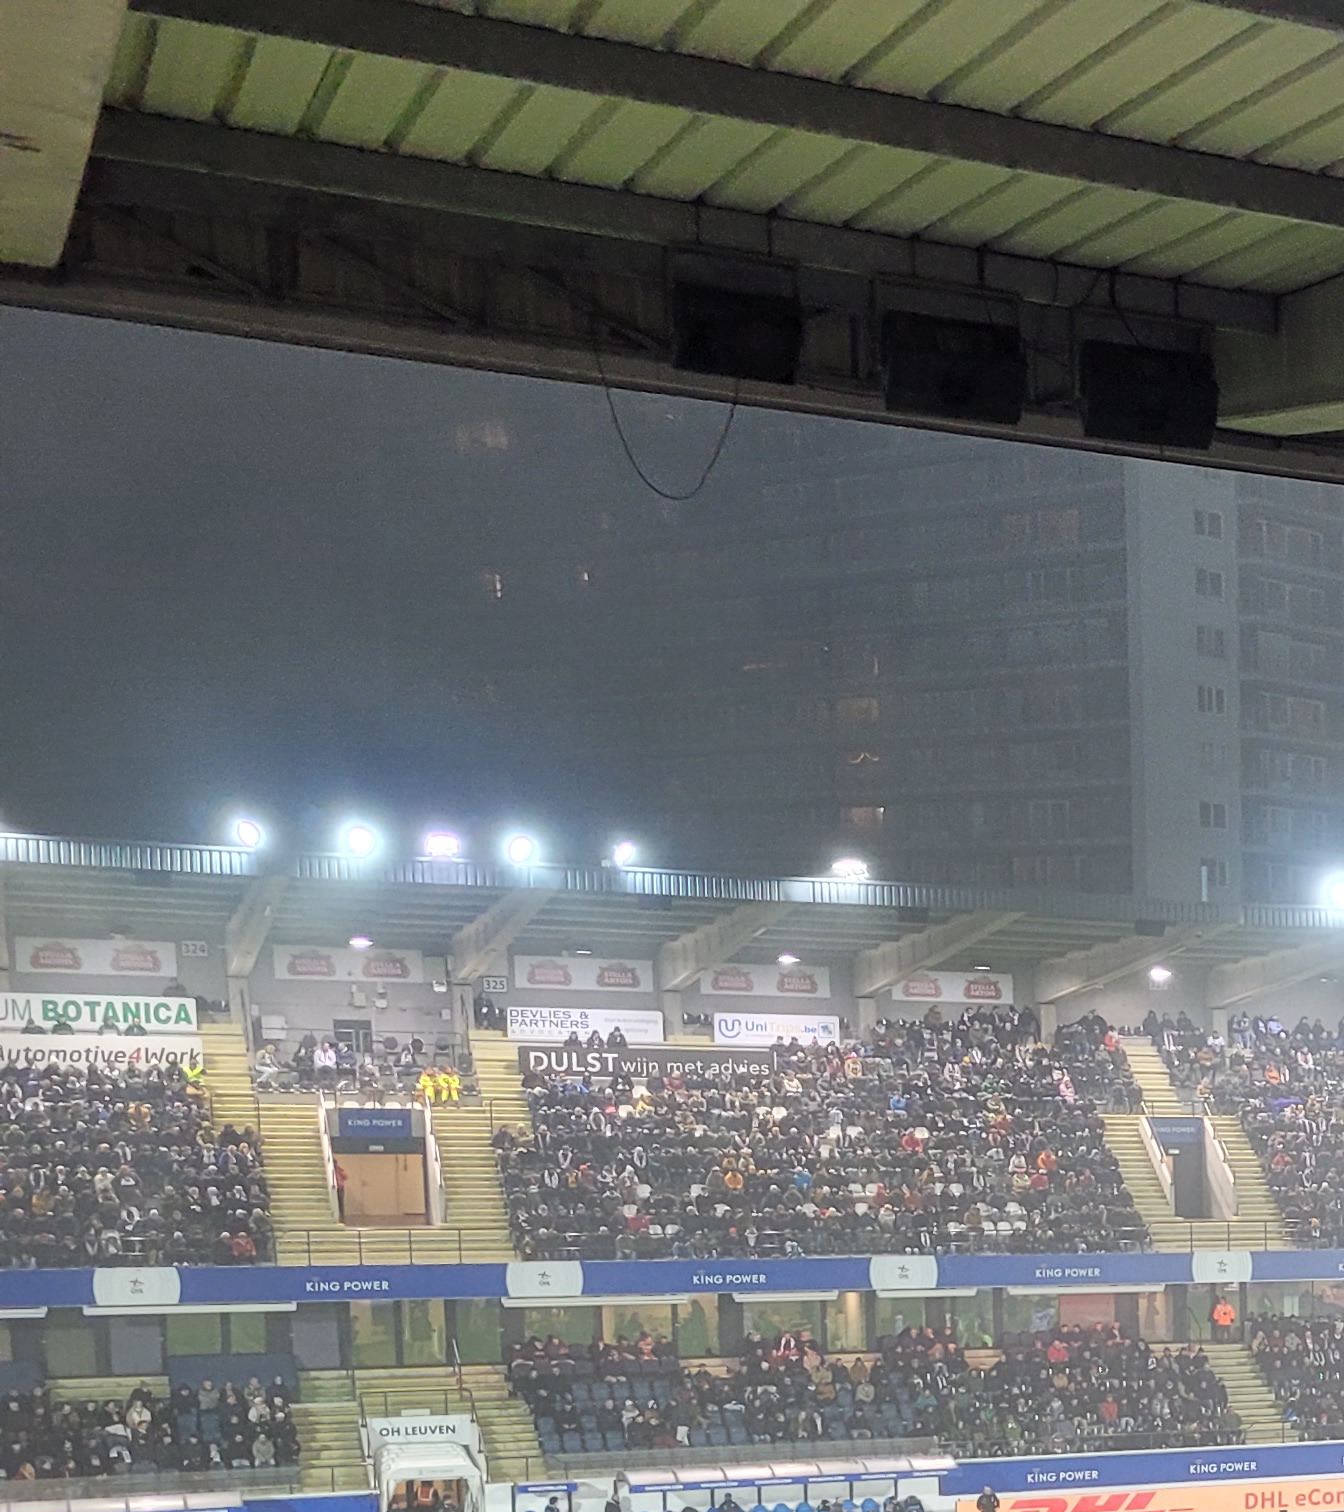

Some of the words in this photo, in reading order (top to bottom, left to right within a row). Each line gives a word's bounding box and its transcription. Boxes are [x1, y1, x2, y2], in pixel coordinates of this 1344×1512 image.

[485, 979, 505, 990] 325
[42, 1000, 193, 1025] BOTANICA
[510, 1010, 572, 1019] DEVLIES
[579, 1011, 589, 1019] &
[510, 1019, 590, 1029] PARTNERS
[0, 1045, 201, 1064] utomotive4Work
[529, 1051, 619, 1072] DULST
[621, 1058, 658, 1077] wijn
[667, 1059, 704, 1075] met
[710, 1058, 770, 1076] advies
[693, 1274, 723, 1284] KING
[726, 1274, 766, 1284] POWER
[1035, 1268, 1062, 1278] KING
[1065, 1267, 1100, 1277] POWER
[306, 1282, 340, 1292] KING
[344, 1281, 389, 1291] POWER
[380, 1427, 401, 1437] OH
[405, 1424, 456, 1436] LEUVEN
[1189, 1463, 1218, 1474] KING
[1220, 1461, 1257, 1472] POWER
[1027, 1471, 1056, 1483] KING
[1060, 1470, 1099, 1481] POWER
[1244, 1491, 1288, 1510] DHL
